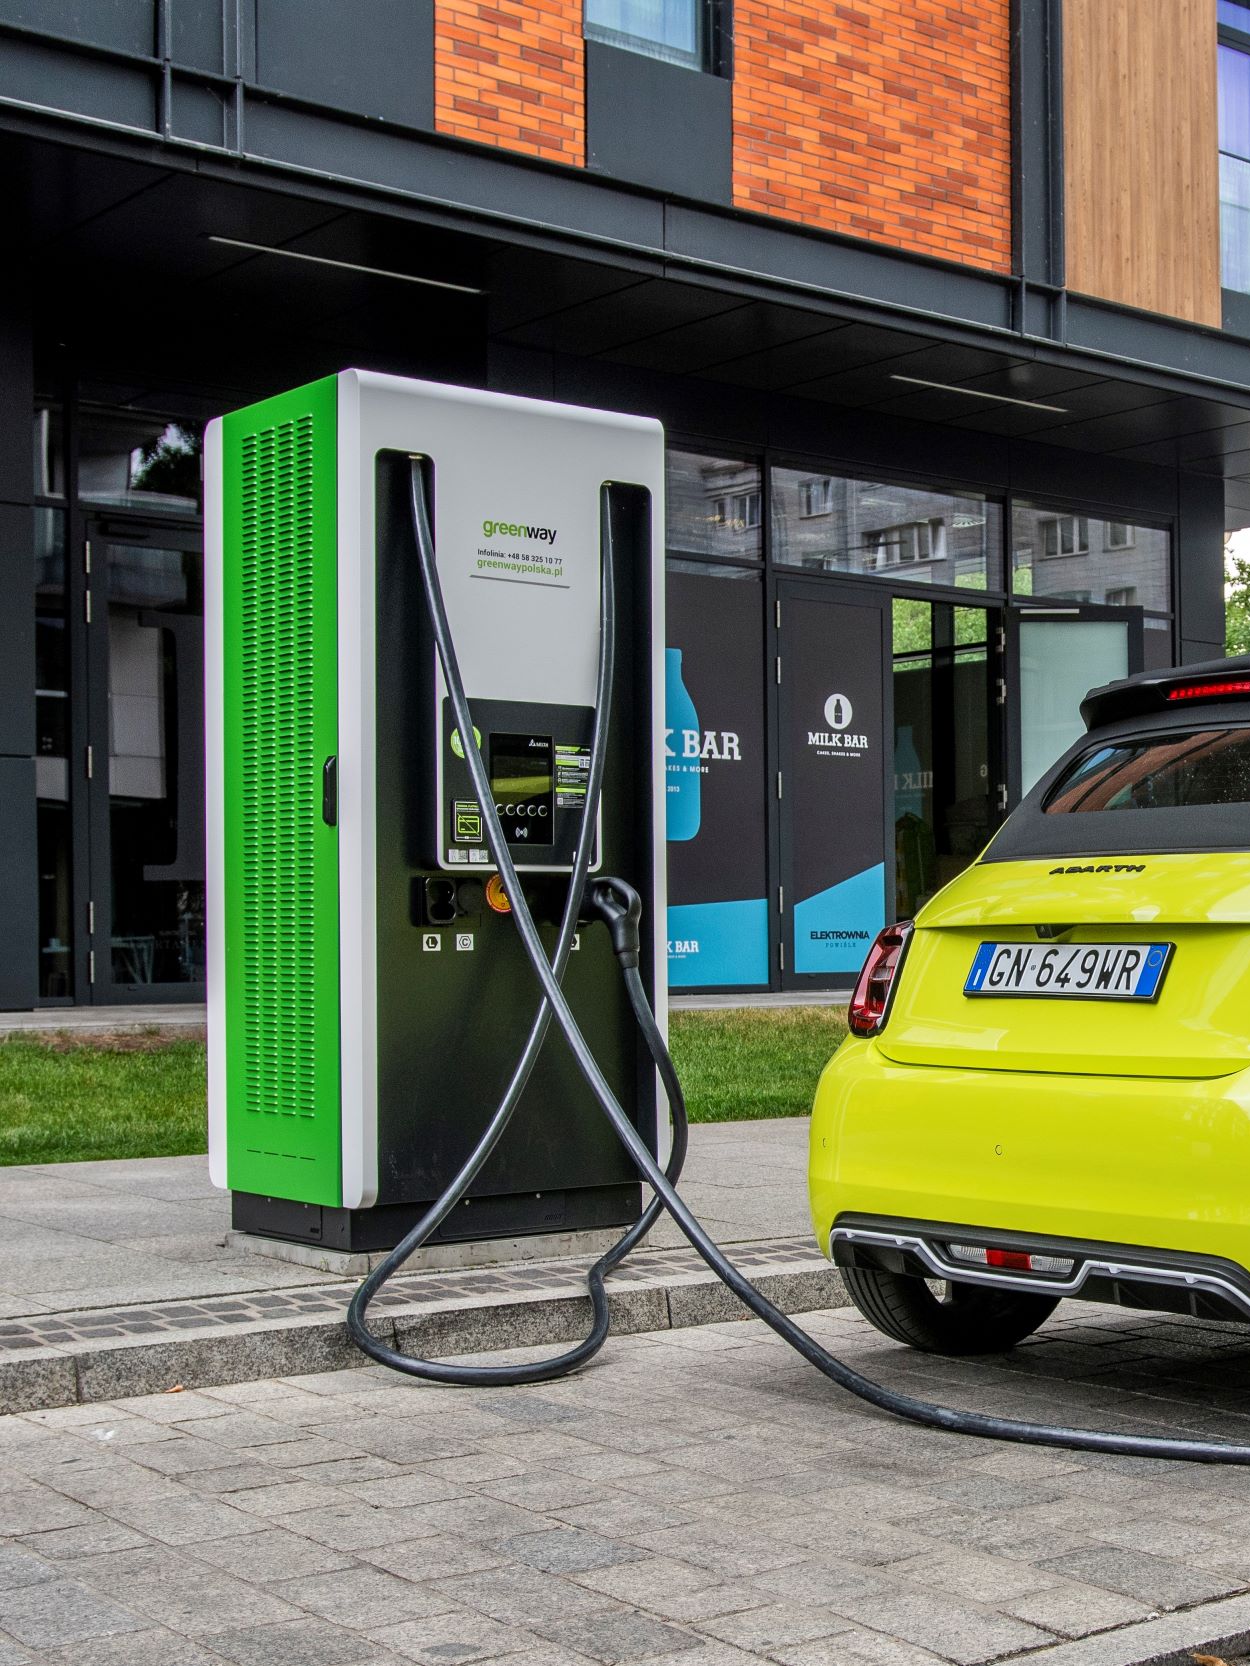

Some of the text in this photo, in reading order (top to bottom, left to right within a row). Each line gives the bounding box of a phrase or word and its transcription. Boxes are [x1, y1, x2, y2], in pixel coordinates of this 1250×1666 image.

[483, 520, 557, 545] greenway
[477, 548, 506, 558] Infolinia:
[531, 555, 544, 563] 325
[477, 559, 563, 578] greenwaypolska.pl
[682, 729, 742, 761] BAR
[807, 732, 869, 749] MILK BAR
[689, 765, 709, 773] MORE
[1049, 864, 1146, 875] ABARTH
[810, 930, 870, 940] ELEKTROWNIA
[675, 940, 700, 953] BAR
[988, 948, 1033, 987] GN
[1035, 948, 1141, 990] 649WR
